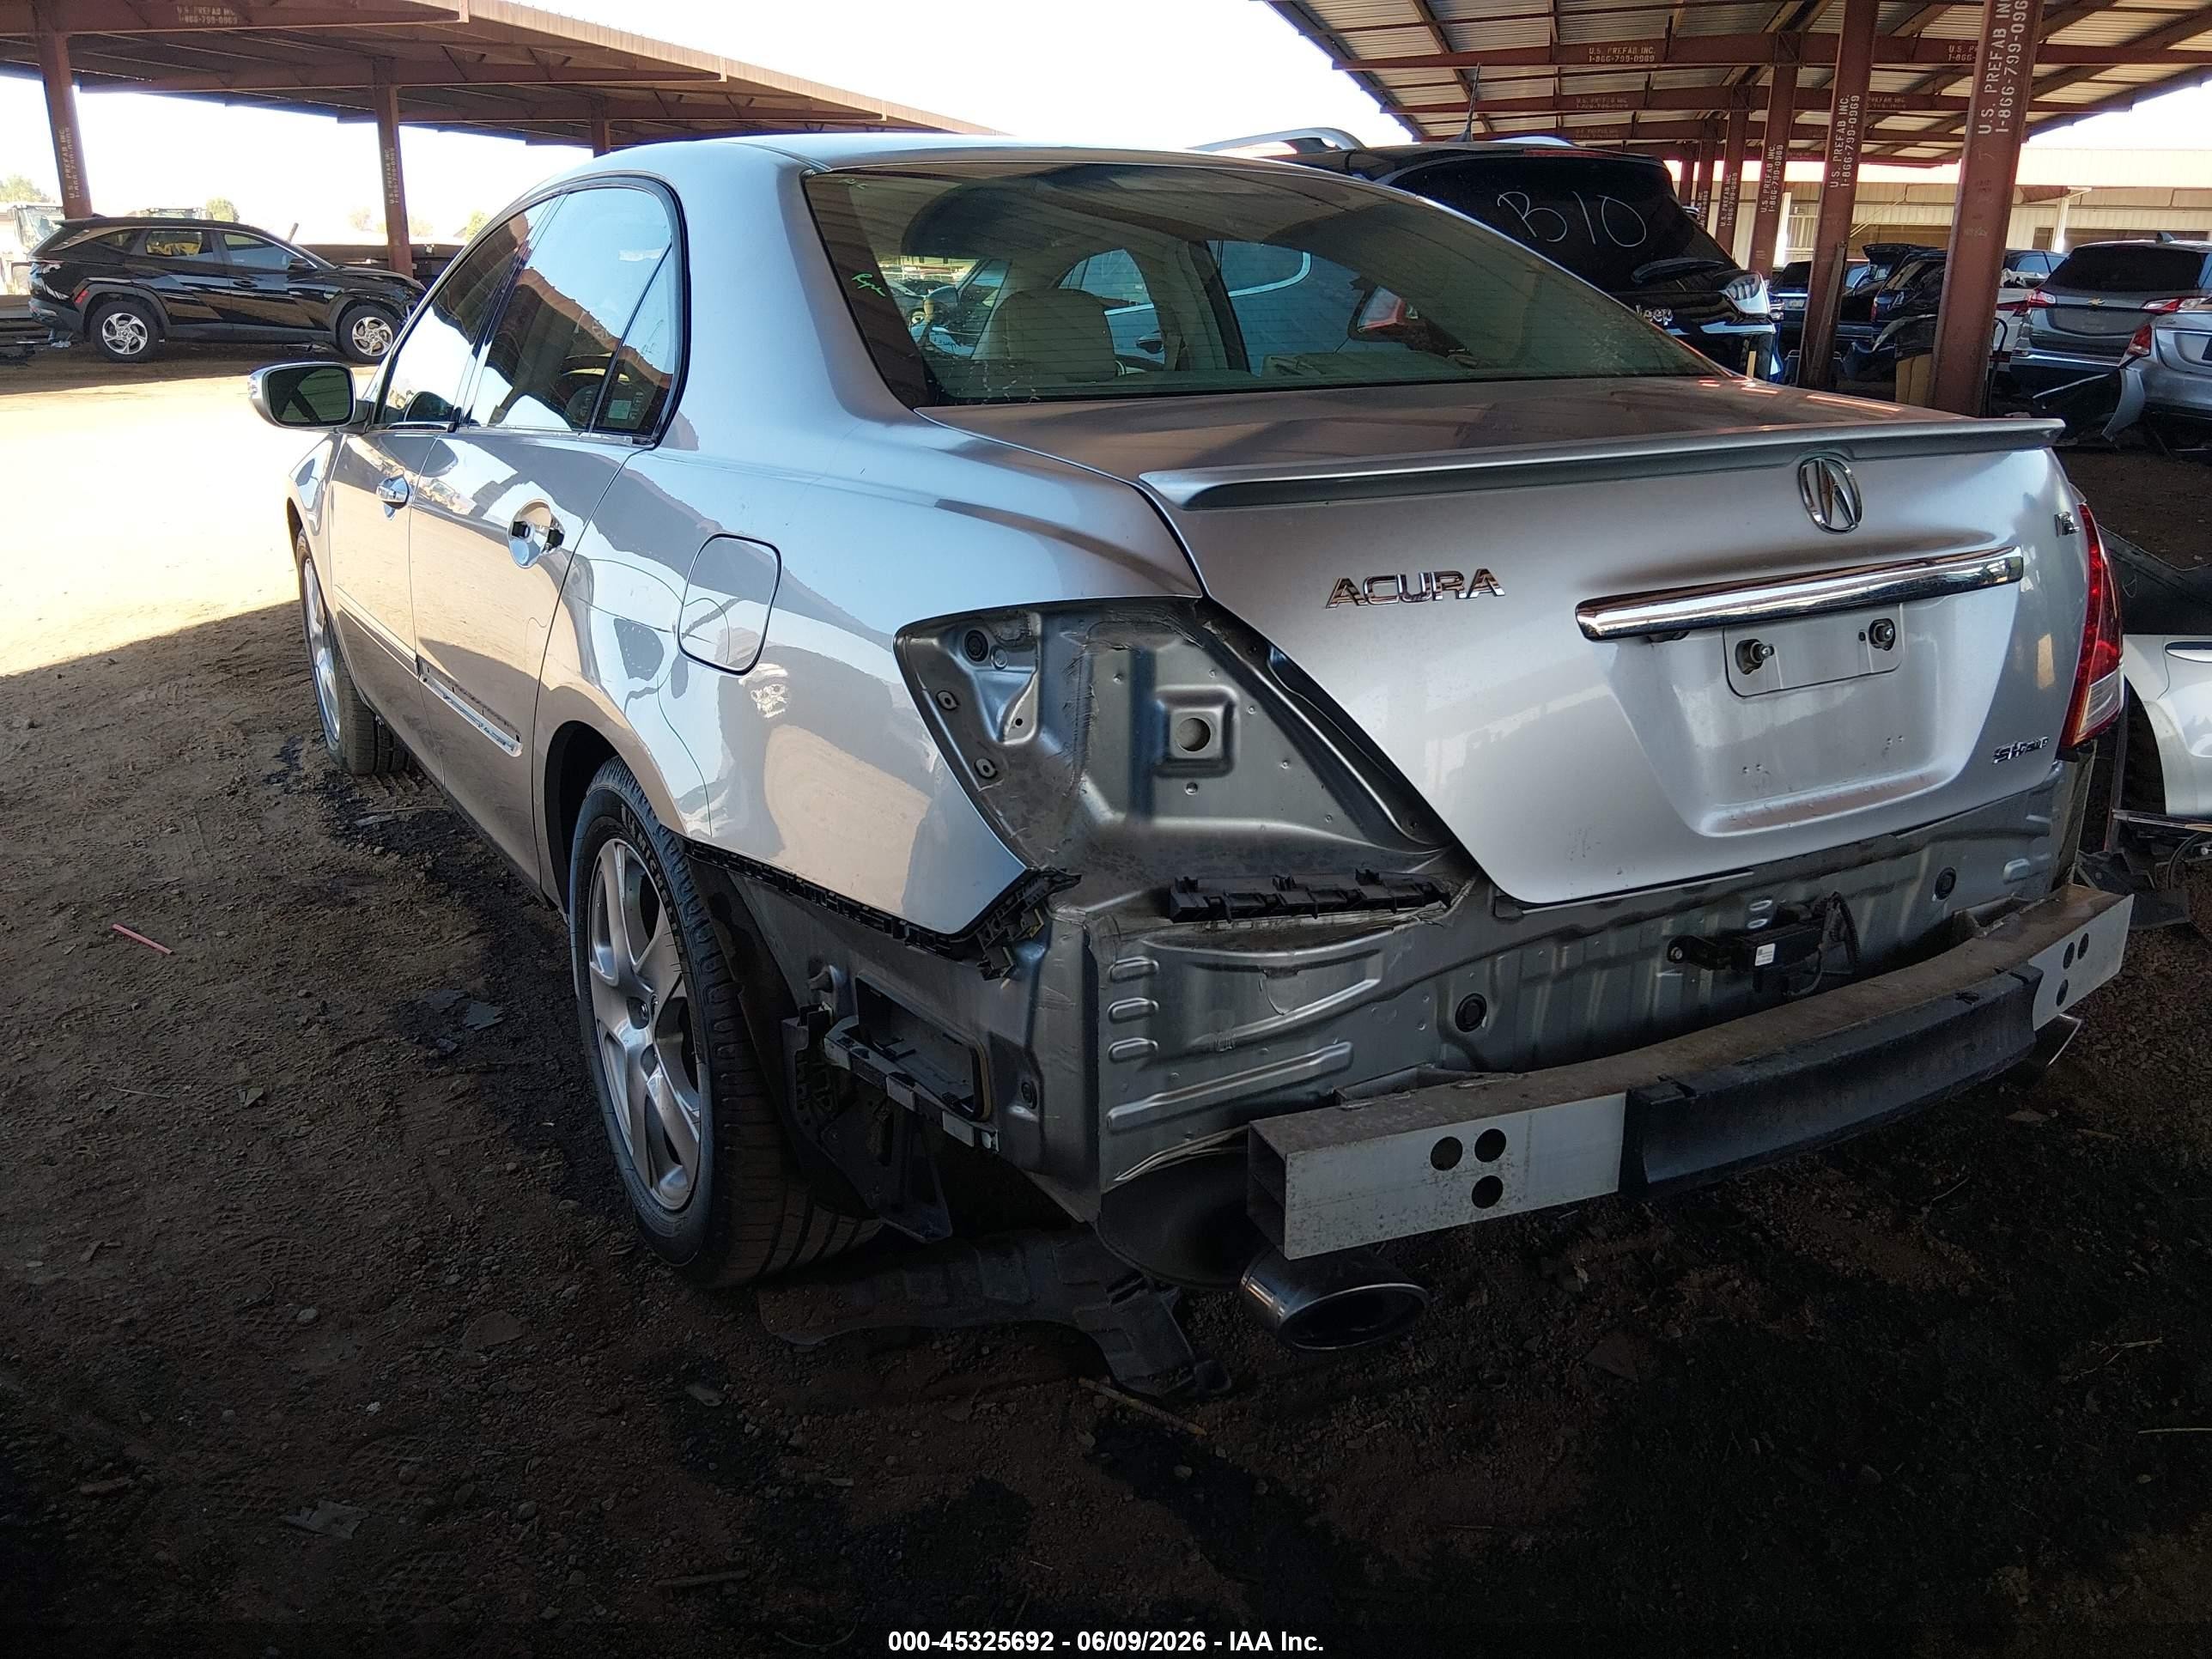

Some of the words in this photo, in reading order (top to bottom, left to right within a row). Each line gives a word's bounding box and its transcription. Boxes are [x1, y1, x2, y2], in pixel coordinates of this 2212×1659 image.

[1995, 0, 2012, 18] IN
[1984, 27, 2007, 93] PREFAB
[1995, 0, 2028, 132] 1-866-799-096
[1838, 94, 1850, 115] INC.
[1978, 103, 1996, 134] U.S.
[1832, 120, 1846, 161] PREFAB
[1840, 94, 1860, 186] 1-866-799-0969
[1763, 163, 1773, 194] PREFAB
[1830, 167, 1841, 187] U.S.
[1326, 568, 1505, 609] ACURA
